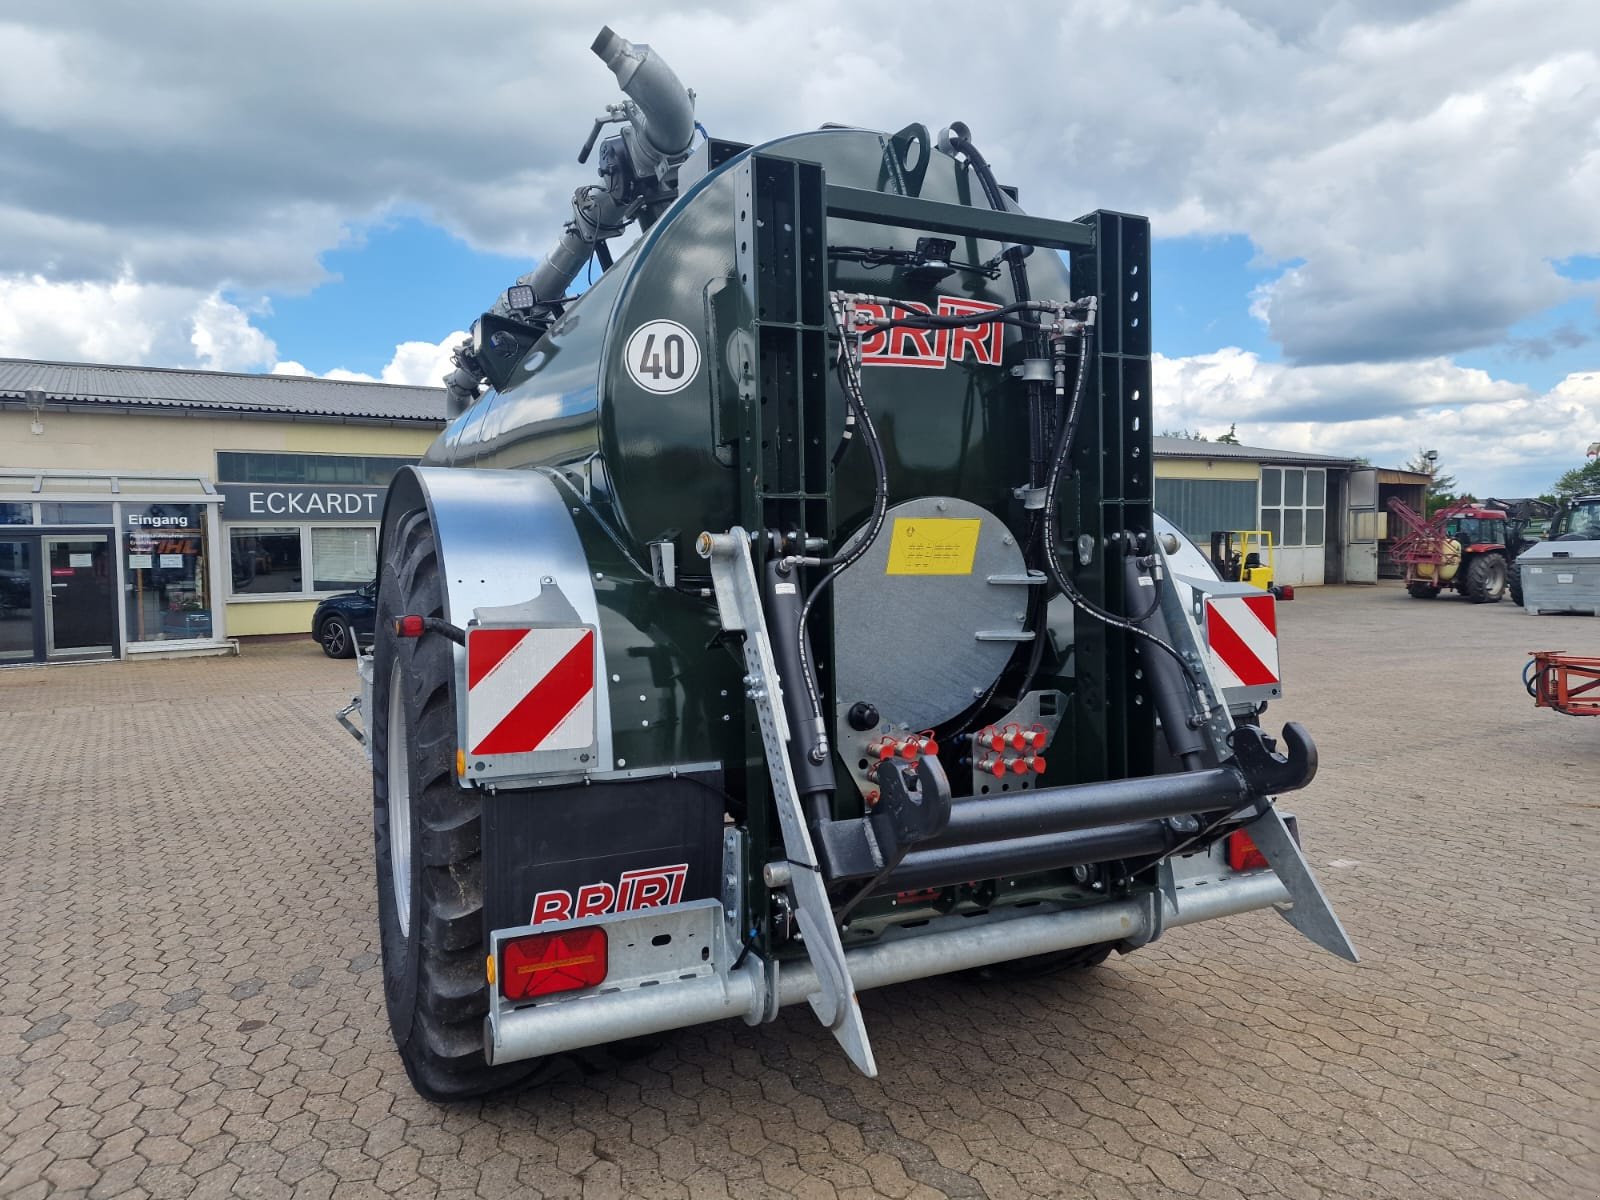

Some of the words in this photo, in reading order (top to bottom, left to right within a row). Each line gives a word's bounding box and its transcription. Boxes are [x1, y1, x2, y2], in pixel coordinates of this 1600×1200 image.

[838, 295, 1004, 369] BRIRI
[640, 334, 685, 380] 40
[128, 514, 188, 527] Eingang
[249, 492, 378, 514] ECKARDT
[530, 864, 689, 926] BRIRI
